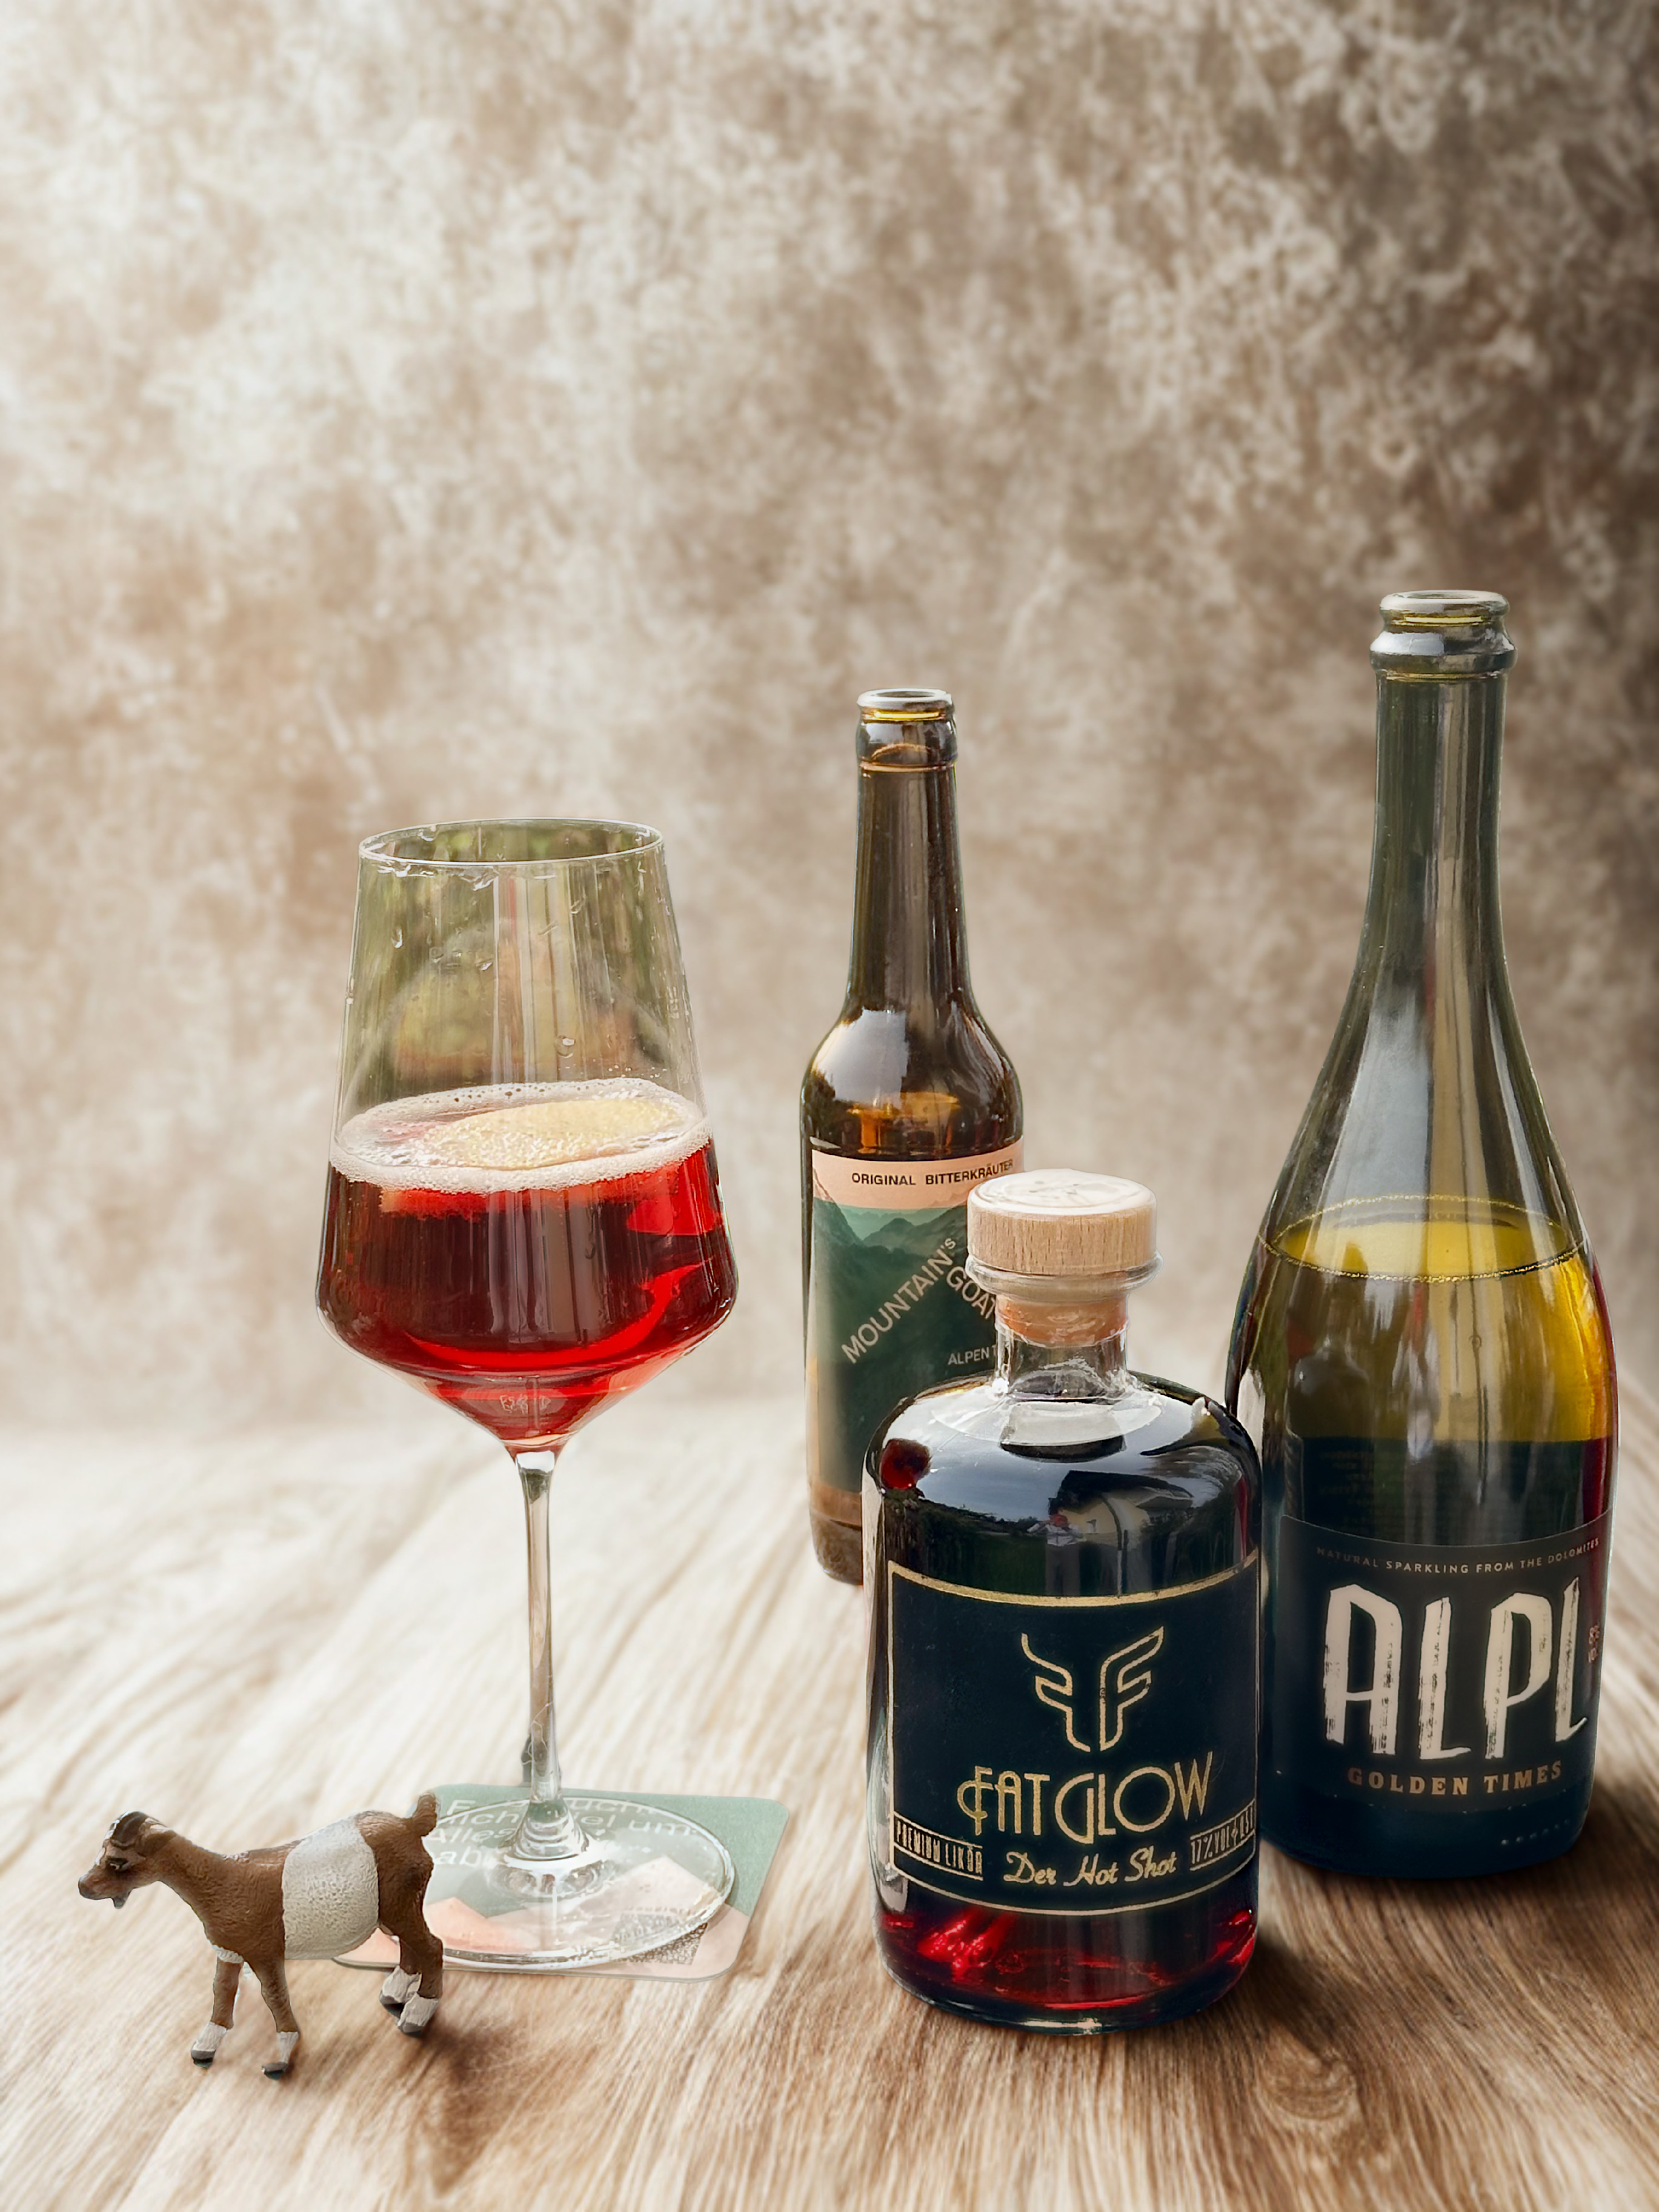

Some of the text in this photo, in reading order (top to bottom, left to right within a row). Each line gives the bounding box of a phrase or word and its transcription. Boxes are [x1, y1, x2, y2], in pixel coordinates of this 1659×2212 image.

[852, 1172, 916, 1186] ORIGINAL
[948, 1346, 989, 1365] ALPEN
[1317, 1538, 1600, 1574] NATURAL SPARKLING FROM THE DOLOMITES
[1323, 1576, 1588, 1759] ALPL
[1348, 1760, 1562, 1795] GOLDEN TIMES
[1003, 1845, 1178, 1886] Der Hot Shot
